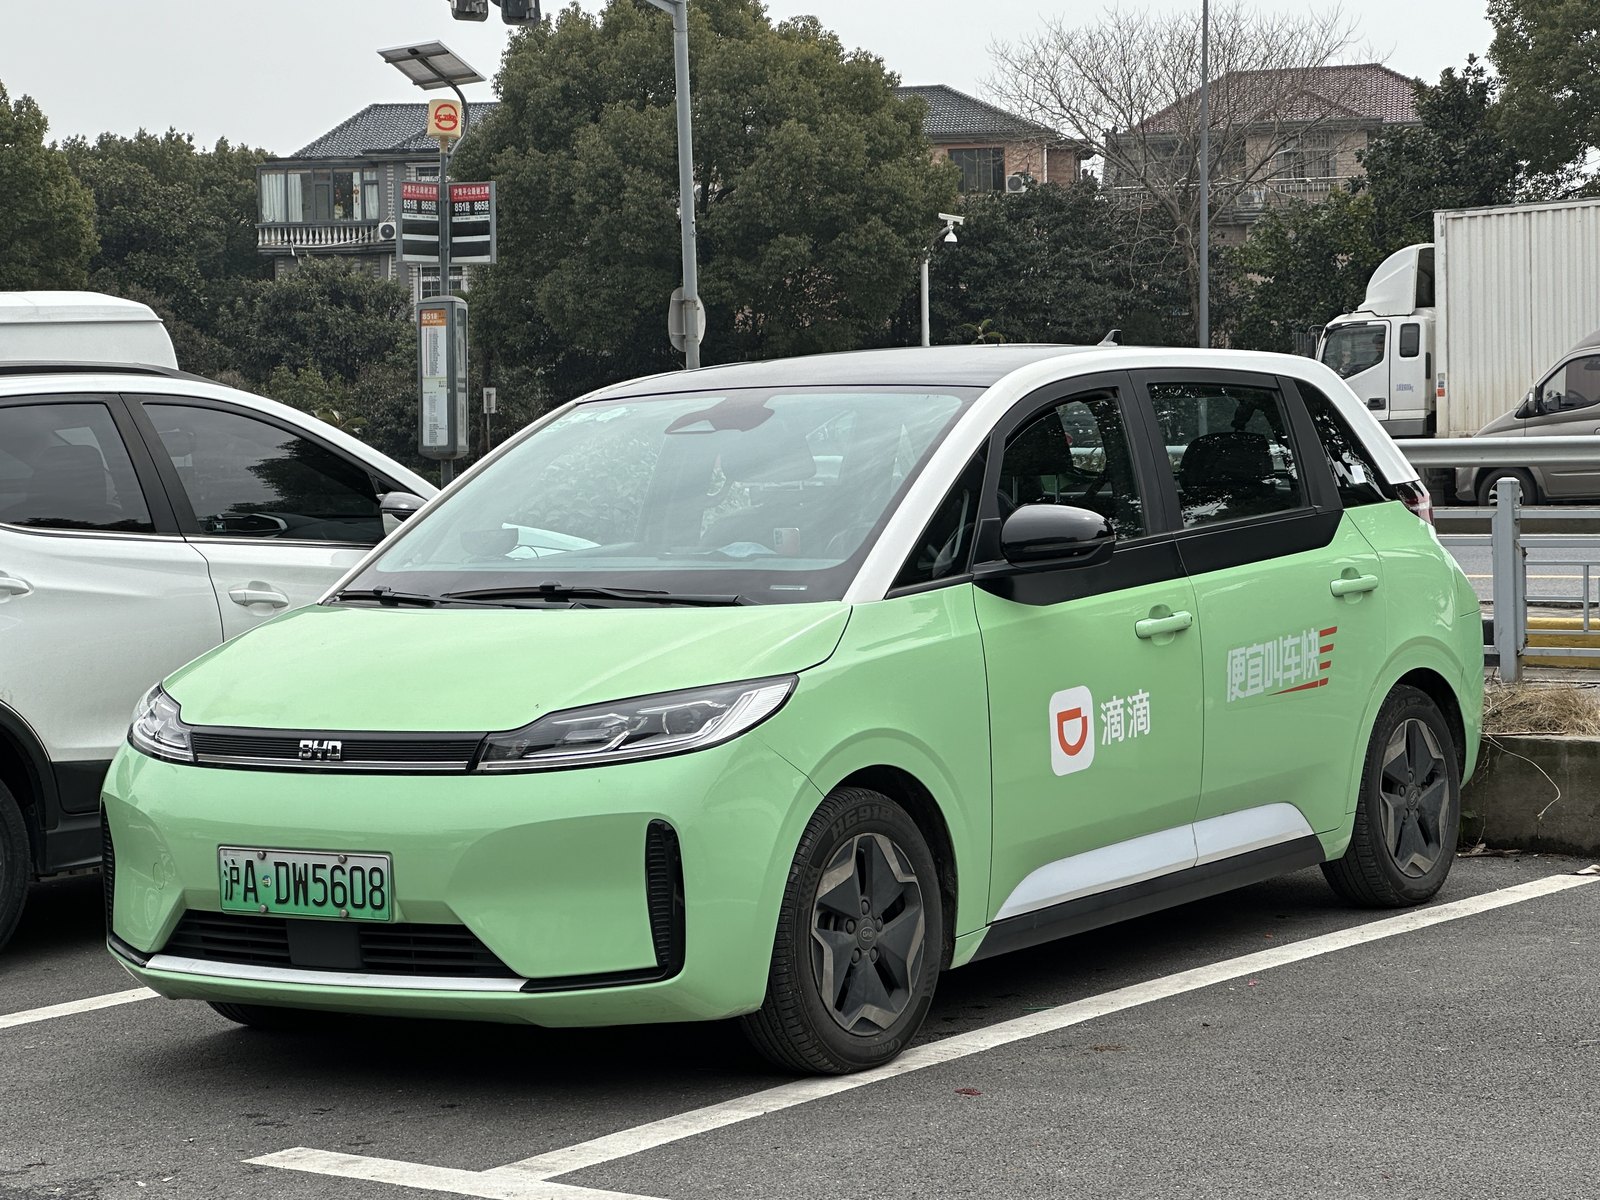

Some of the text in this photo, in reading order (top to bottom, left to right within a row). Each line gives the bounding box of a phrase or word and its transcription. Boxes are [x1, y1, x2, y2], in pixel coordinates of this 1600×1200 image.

[454, 202, 470, 212] 851路
[1226, 628, 1320, 703] 便宜叫车快
[1101, 689, 1150, 745] 滴滴
[299, 740, 342, 759] BYD
[223, 859, 385, 910] 沪A DW5608
